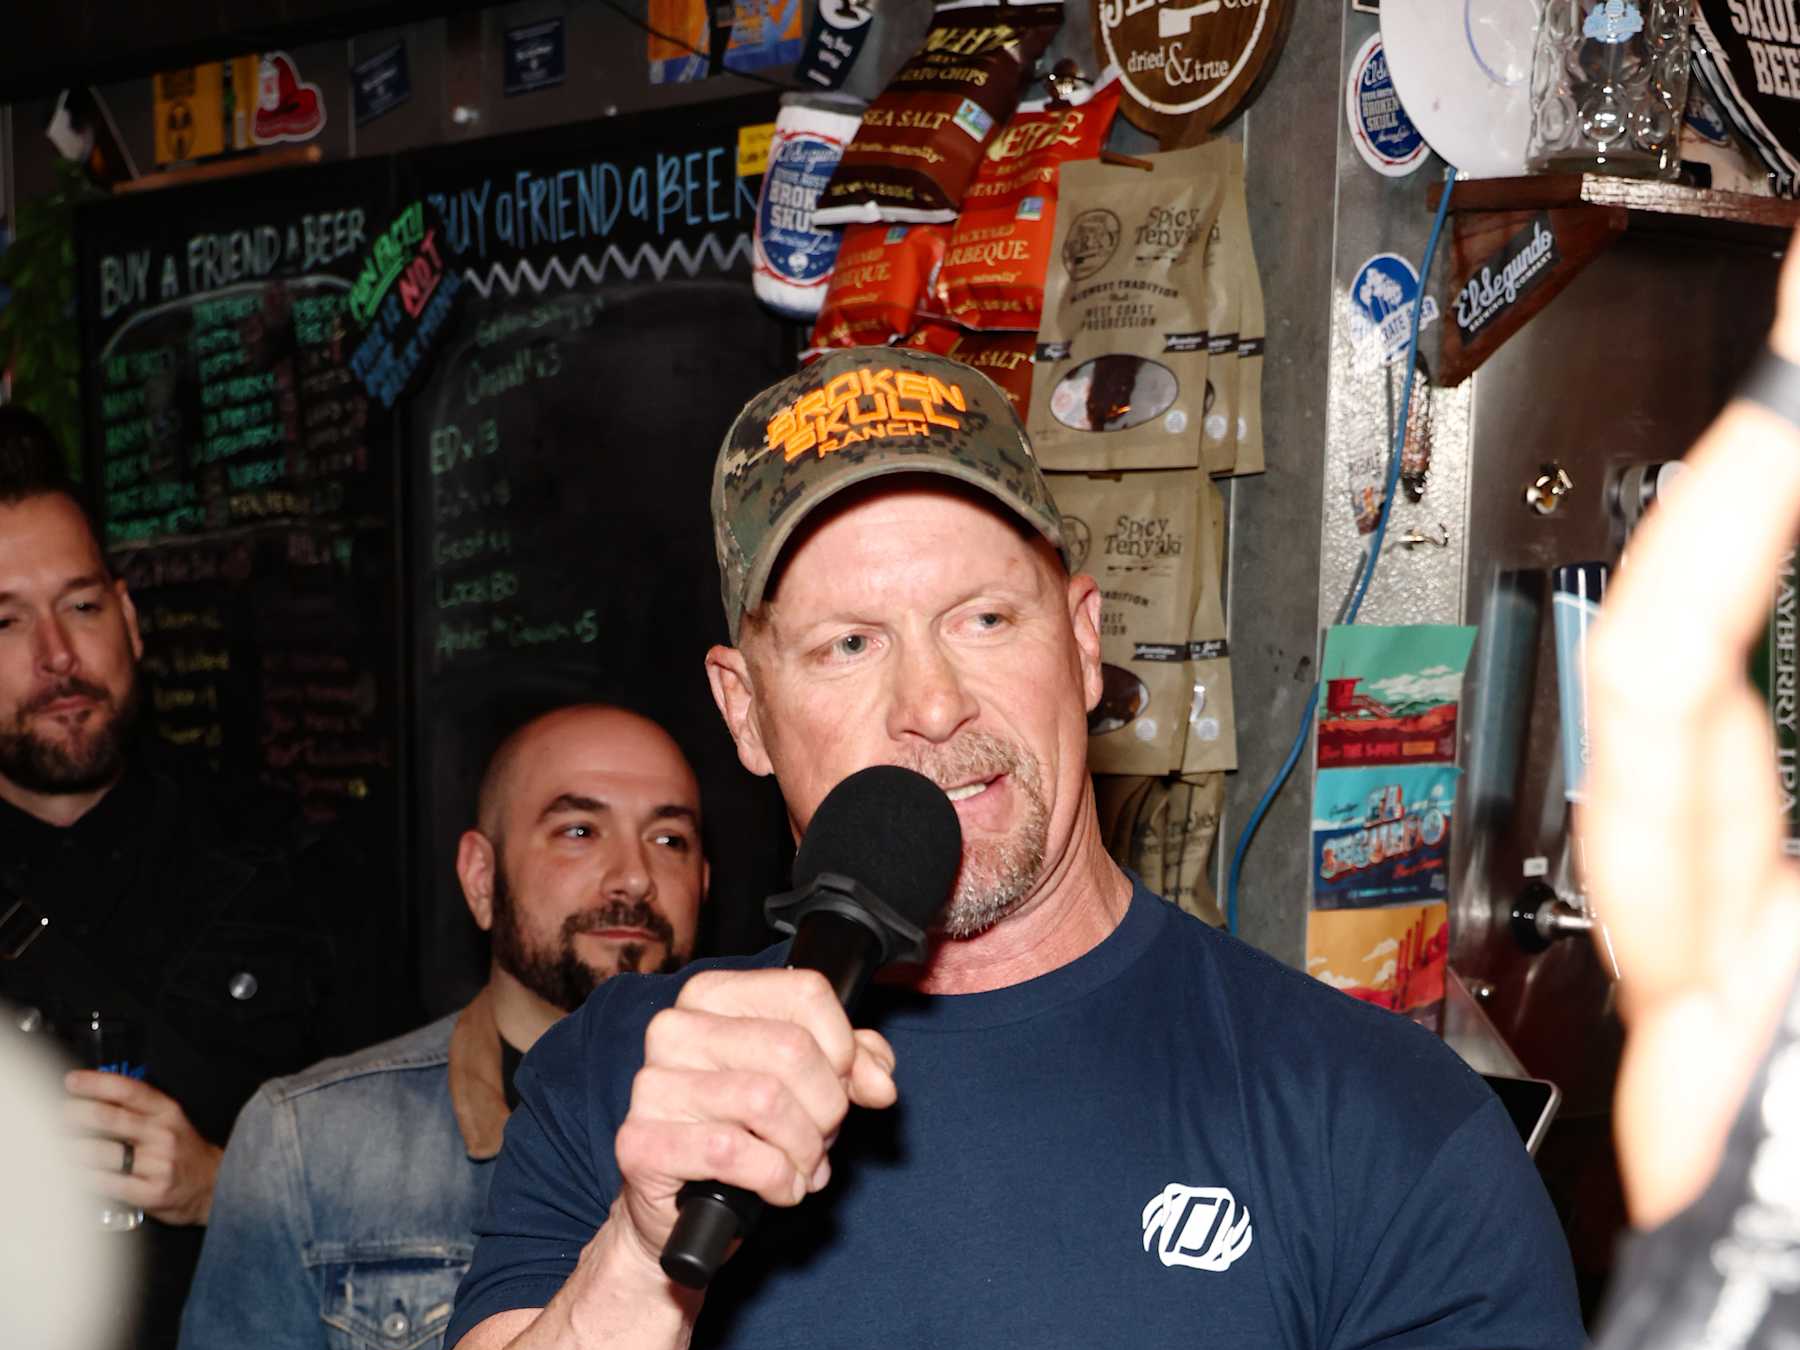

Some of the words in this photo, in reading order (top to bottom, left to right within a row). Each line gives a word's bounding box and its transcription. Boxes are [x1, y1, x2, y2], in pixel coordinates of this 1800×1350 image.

[1128, 47, 1165, 73] dried
[1165, 42, 1194, 86] &
[1195, 60, 1229, 81] true
[862, 109, 893, 126] SEA
[897, 110, 950, 129] SALT
[516, 162, 623, 249] FRIEND
[630, 166, 649, 222] a
[769, 180, 820, 211] BROK
[1149, 207, 1200, 233] Spicy
[100, 250, 150, 320] BUY
[160, 254, 180, 298] A
[187, 225, 281, 292] FRIEND
[302, 207, 367, 272] BEER
[1118, 280, 1179, 299] TRADITION
[1117, 304, 1154, 317] COAST
[974, 350, 1027, 370] SALT
[767, 368, 967, 451] BROKEN
[783, 392, 960, 463] SKULL
[817, 421, 929, 458] RANCH
[1117, 514, 1170, 540] Spicy
[1104, 533, 1183, 559] Teriyaki
[1100, 590, 1150, 607] ADITION
[1773, 550, 1797, 731] MAYBERRY
[1772, 750, 1798, 815] IPA
